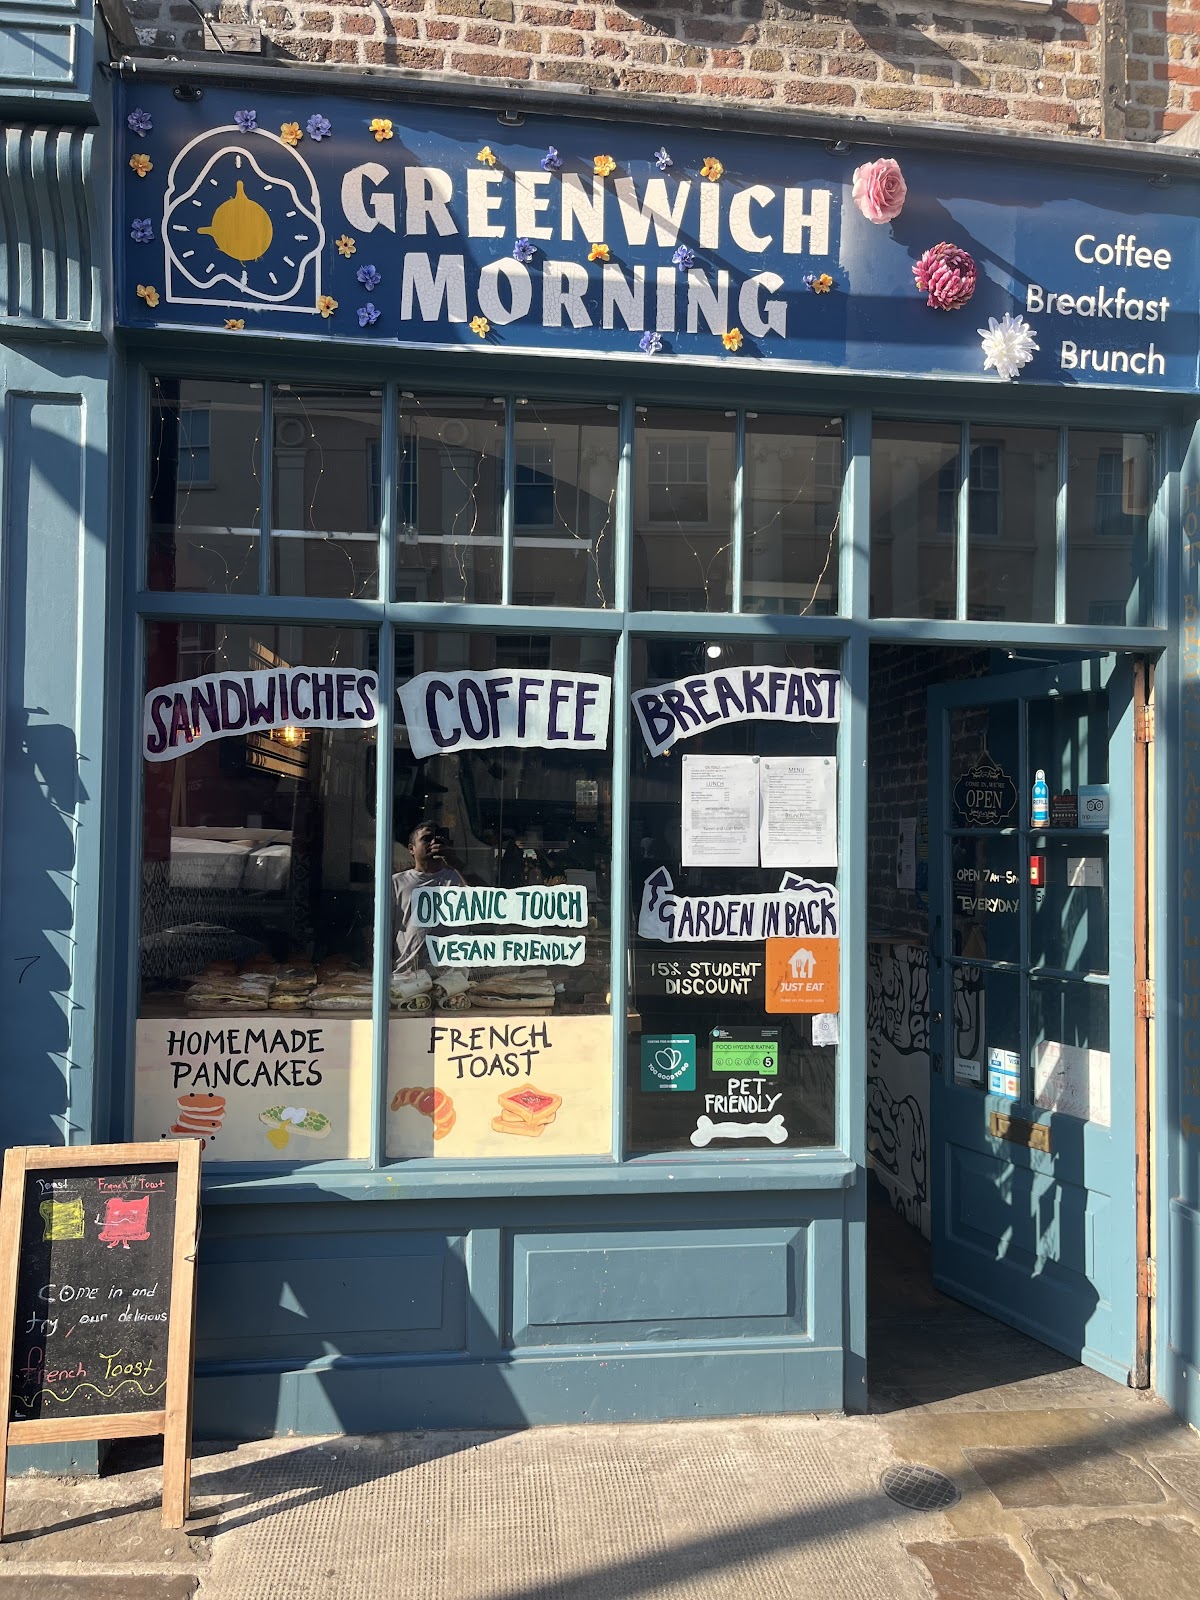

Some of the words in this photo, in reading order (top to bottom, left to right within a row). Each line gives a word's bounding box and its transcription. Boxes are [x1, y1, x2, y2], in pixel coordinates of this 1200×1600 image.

[340, 162, 831, 257] GREENWICH
[1074, 234, 1172, 270] Coffee
[399, 251, 789, 339] MORNING
[1026, 283, 1170, 323] Breakfast
[1060, 340, 1166, 376] Brunch
[147, 672, 378, 753] SANDWICHES
[425, 676, 599, 748] COFFEE
[637, 670, 841, 747] BREAKFAST
[966, 789, 1003, 809] OPEN
[957, 867, 980, 882] OPEN
[416, 889, 508, 924] ORGANIC
[515, 890, 583, 922] TOUCH
[658, 900, 755, 939] GARDEN
[761, 900, 780, 938] IN
[784, 898, 837, 937] BACK
[957, 895, 1020, 913] EVERYDAY
[431, 939, 497, 962] VEGAN
[503, 939, 583, 962] FRIENDLY
[651, 961, 682, 977] 15%
[687, 961, 762, 978] STUDENT
[665, 977, 753, 995] DISCOUNT
[780, 982, 804, 993] JUST
[805, 982, 825, 992] EAT
[166, 1028, 325, 1056] HOMEMADE
[427, 1020, 553, 1054] FRENCH
[170, 1058, 323, 1089] PANCAKES
[447, 1049, 540, 1079] TOAST
[648, 1063, 658, 1075] TOO
[657, 1073, 675, 1081] GOOD
[764, 1057, 772, 1067] 5
[728, 1078, 767, 1096] PET
[704, 1093, 783, 1114] FRIENDLY
[98, 1178, 128, 1190] French
[139, 1179, 165, 1189] Toast
[108, 1285, 123, 1299] in
[26, 1311, 59, 1337] try
[118, 1303, 168, 1322] delicious
